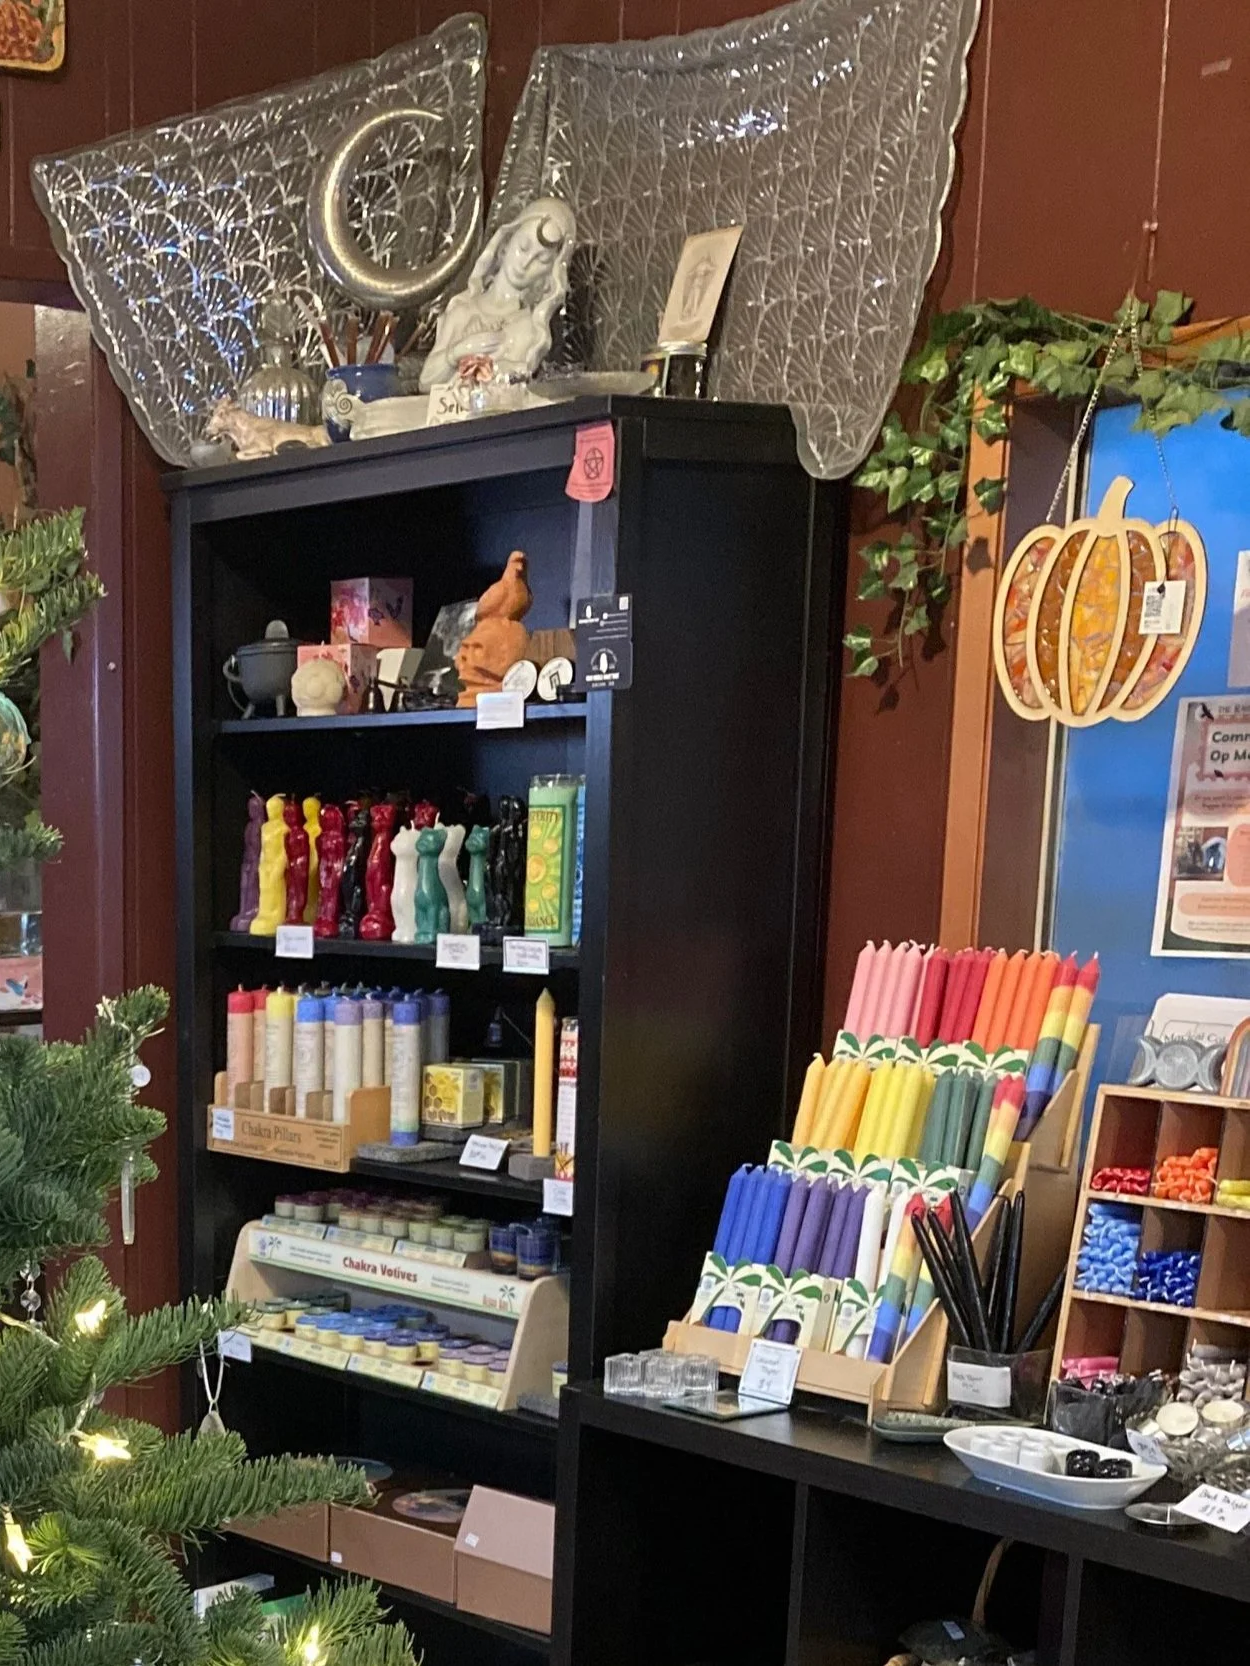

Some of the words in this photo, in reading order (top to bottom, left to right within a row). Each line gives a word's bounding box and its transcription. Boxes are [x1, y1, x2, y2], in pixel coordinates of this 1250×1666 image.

[1210, 750, 1230, 764] Op
[241, 1120, 272, 1140] Chakra
[273, 1125, 303, 1144] Pillars
[342, 1256, 378, 1276] Chakra
[380, 1264, 418, 1284] Votives
